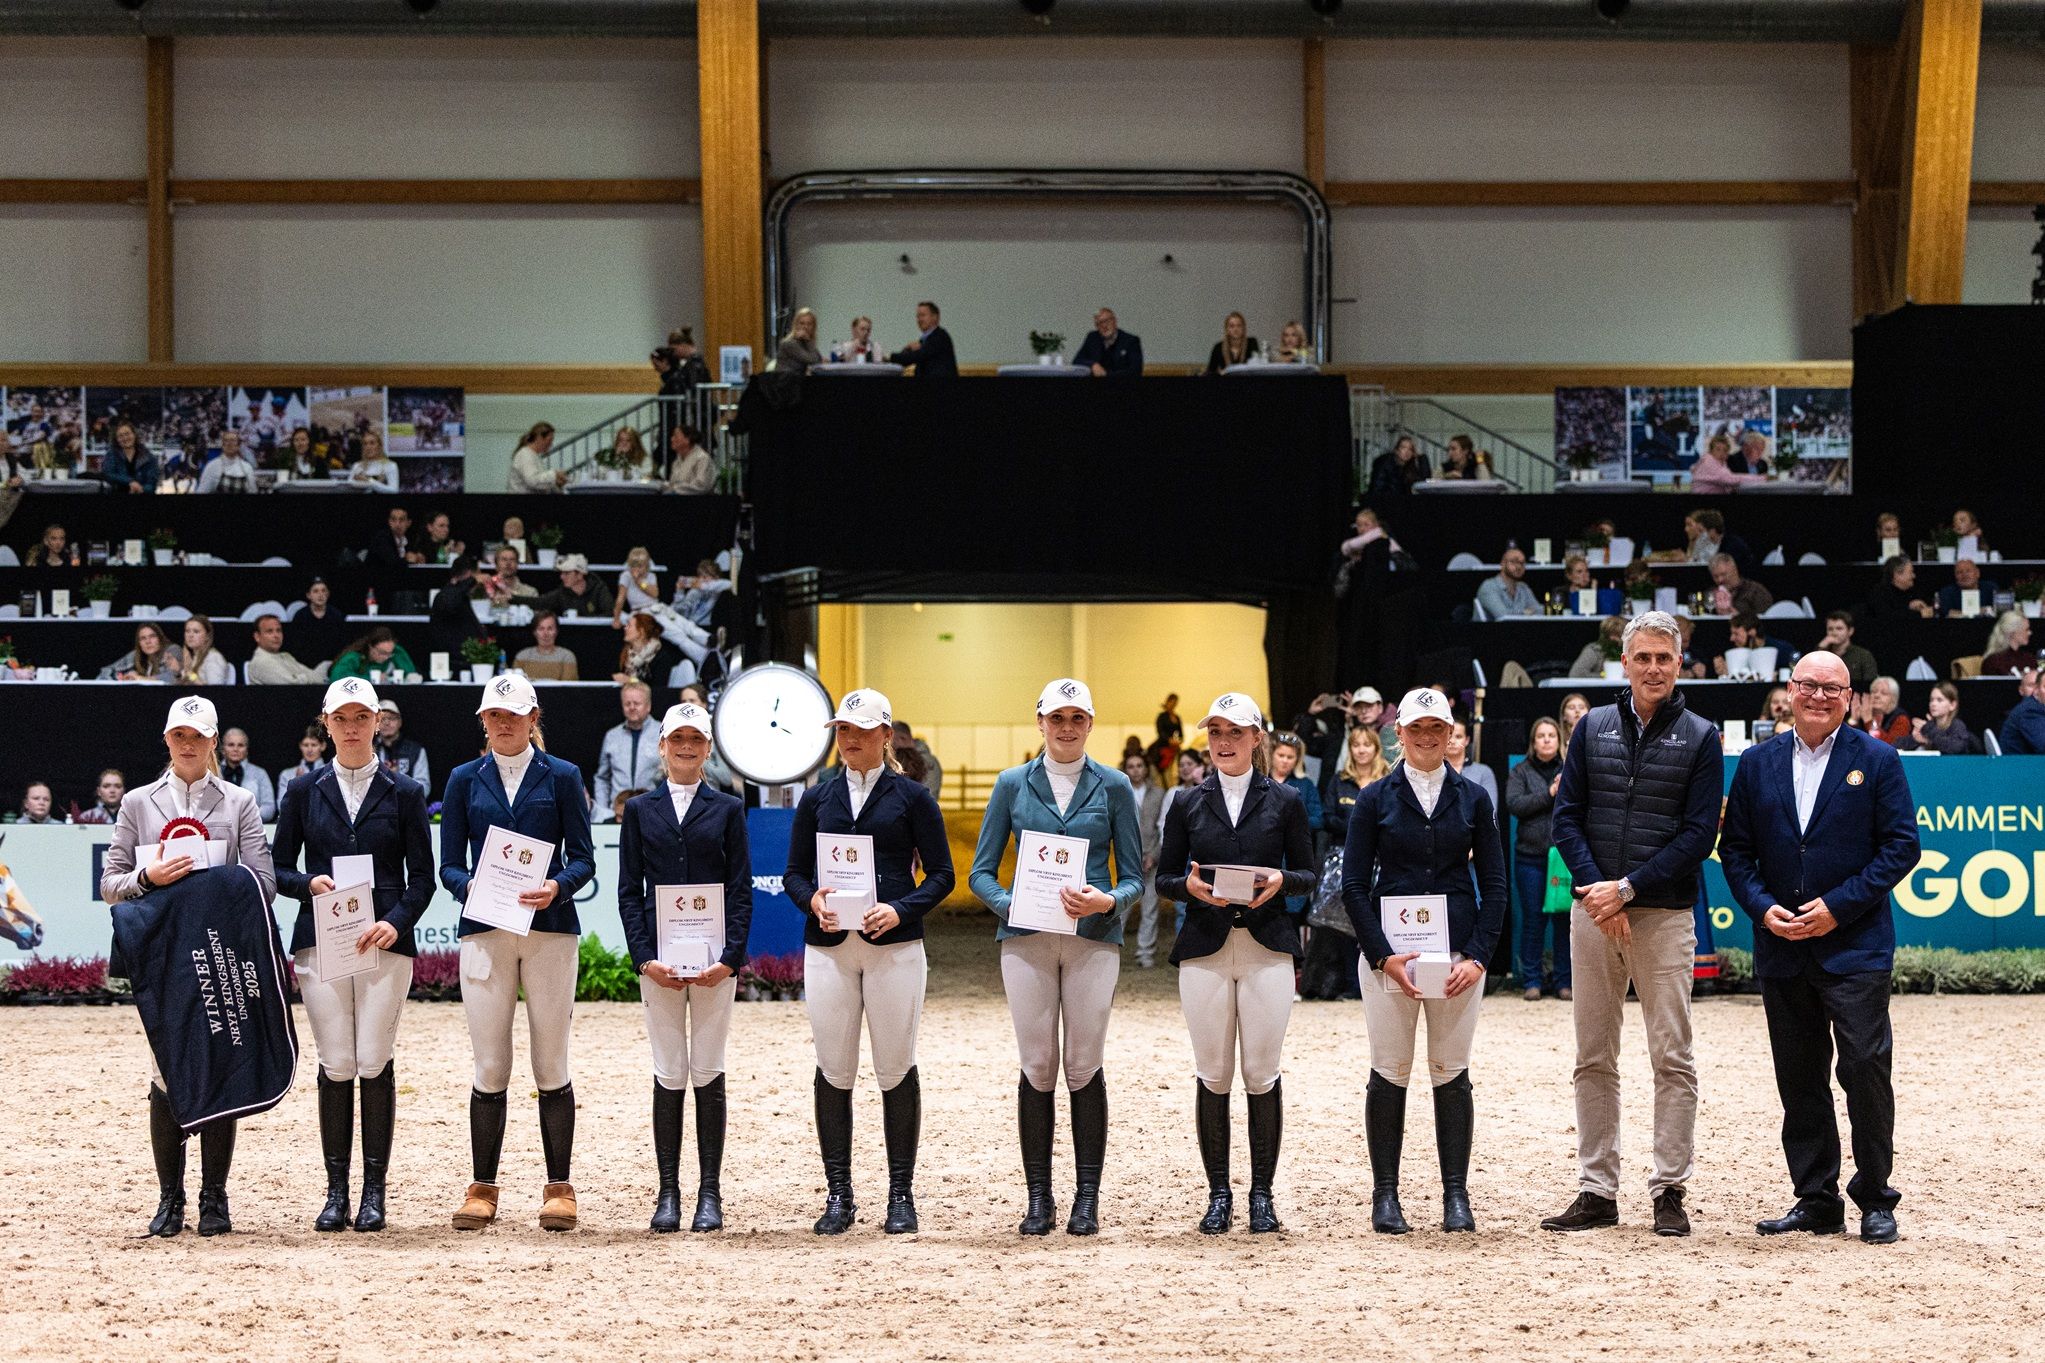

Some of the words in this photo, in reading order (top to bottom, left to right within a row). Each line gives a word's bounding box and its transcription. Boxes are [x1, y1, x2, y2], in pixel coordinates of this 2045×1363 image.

[191, 948, 224, 1035] WINNER
[207, 928, 234, 1007] KINGSRENT
[225, 947, 248, 1021] UNGDOMSCUP
[241, 960, 261, 999] 2025
[226, 1009, 243, 1047] NRYF
